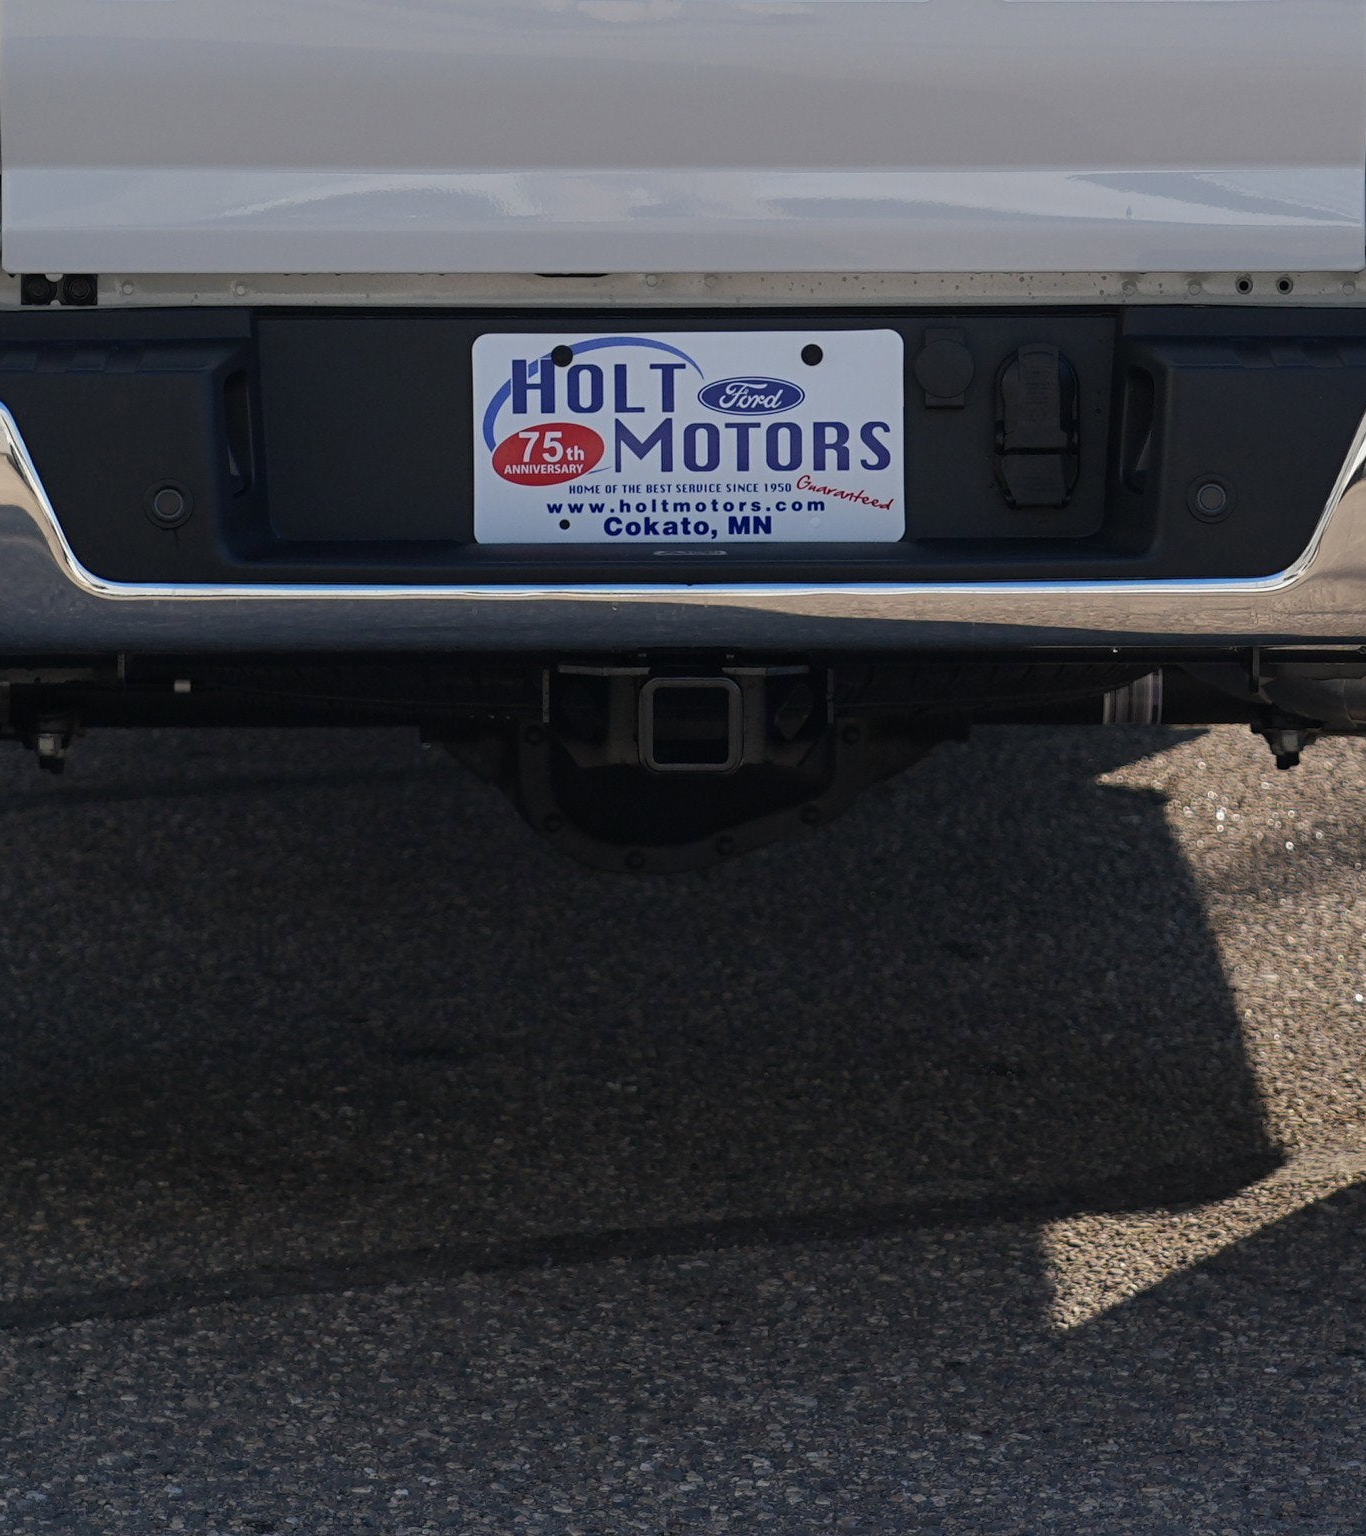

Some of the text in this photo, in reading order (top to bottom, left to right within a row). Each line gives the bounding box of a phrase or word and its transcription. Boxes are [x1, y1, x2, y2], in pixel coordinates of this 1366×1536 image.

[512, 359, 686, 414] HOLT
[719, 382, 784, 409] Ford
[518, 431, 585, 463] 75th
[615, 418, 891, 473] MOTORS
[504, 464, 584, 475] ANNIVERSARY
[568, 483, 792, 494] HOME OF THE BEST SERVICE SINCE 1950
[796, 474, 894, 511] Guaranteed
[546, 499, 825, 514] www.holtmotors.com
[603, 516, 772, 539] Cokato, MN
